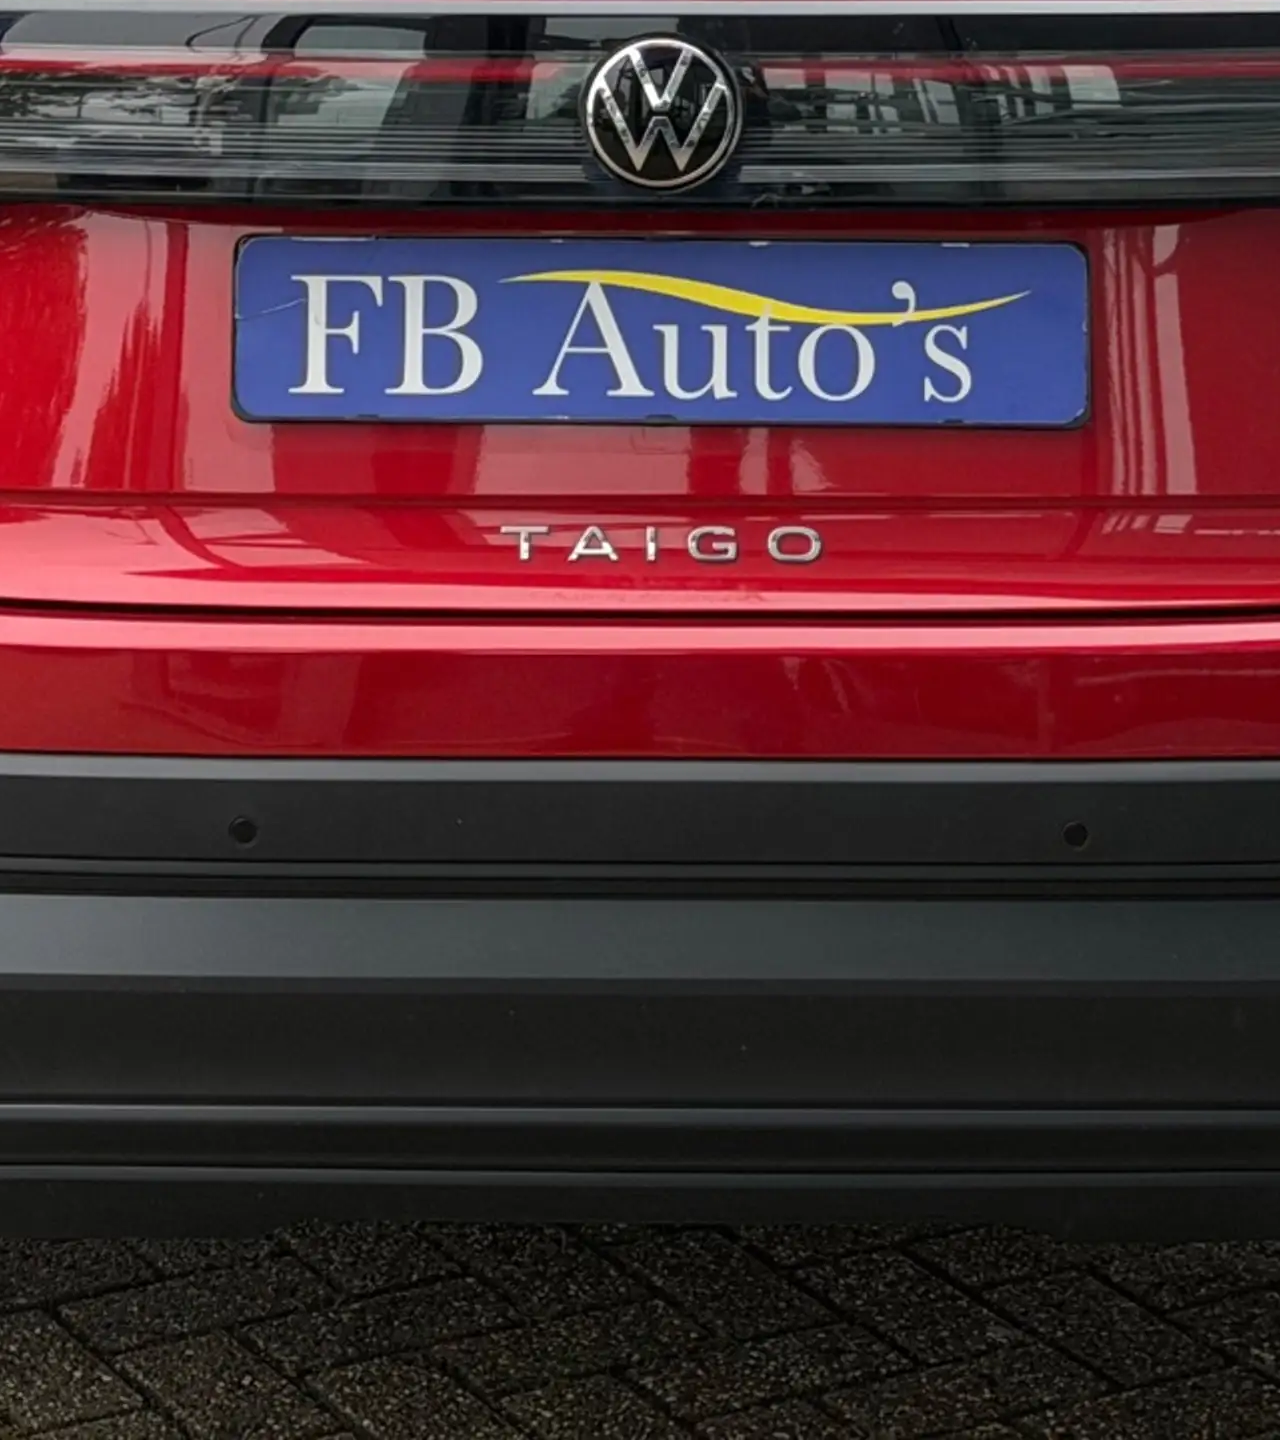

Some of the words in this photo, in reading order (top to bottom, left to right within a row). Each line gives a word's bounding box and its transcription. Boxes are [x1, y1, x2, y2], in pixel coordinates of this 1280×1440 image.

[288, 272, 484, 396] FB
[532, 279, 972, 402] Auto's
[499, 523, 824, 562] TAIGO
